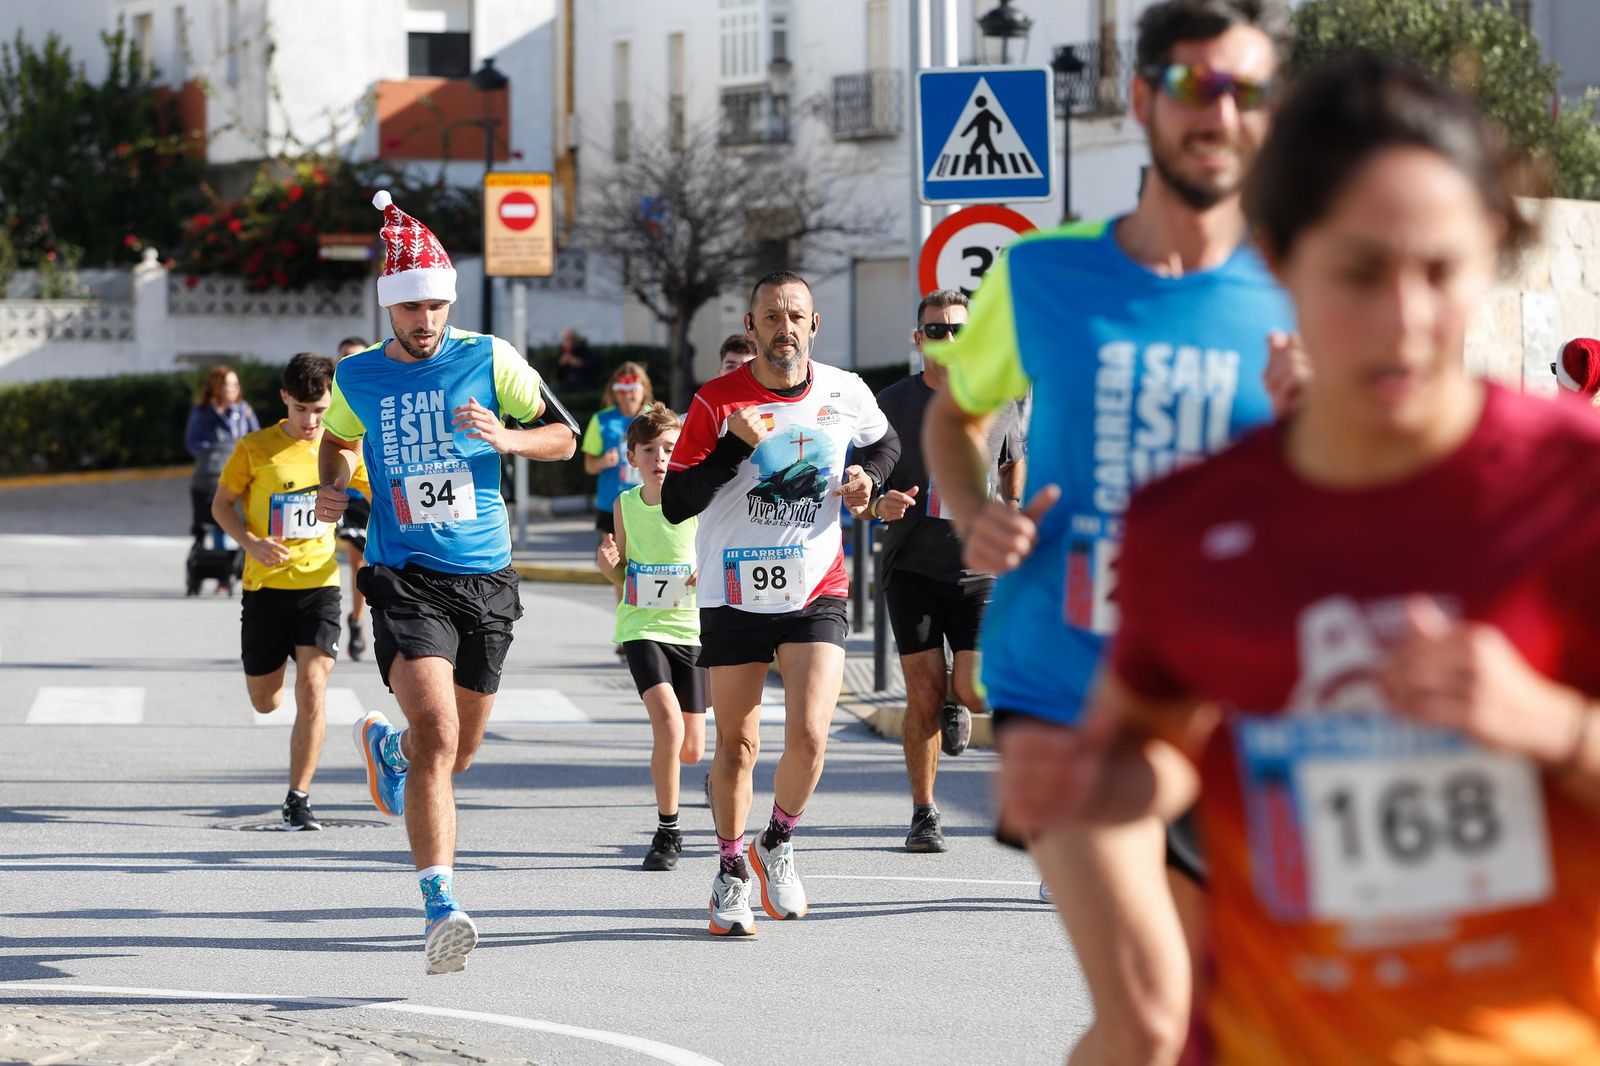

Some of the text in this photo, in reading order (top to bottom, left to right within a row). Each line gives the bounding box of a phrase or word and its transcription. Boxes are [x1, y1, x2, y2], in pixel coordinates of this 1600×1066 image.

[1142, 342, 1240, 393] SAN
[401, 390, 445, 414] SAN
[380, 396, 399, 467] ARRERA
[400, 411, 453, 445] SIL
[401, 441, 457, 463] VES
[390, 461, 469, 474] III CARRERA
[419, 480, 456, 507] 34
[294, 509, 317, 527] 10
[747, 495, 774, 519] Vive
[789, 497, 818, 523] vida
[727, 550, 739, 558] III
[743, 548, 801, 558] CARRERA
[640, 565, 689, 573] CARRERA
[725, 562, 736, 570] SAN
[752, 566, 787, 590] 98
[654, 580, 669, 598] 7
[1326, 771, 1503, 867] 168
